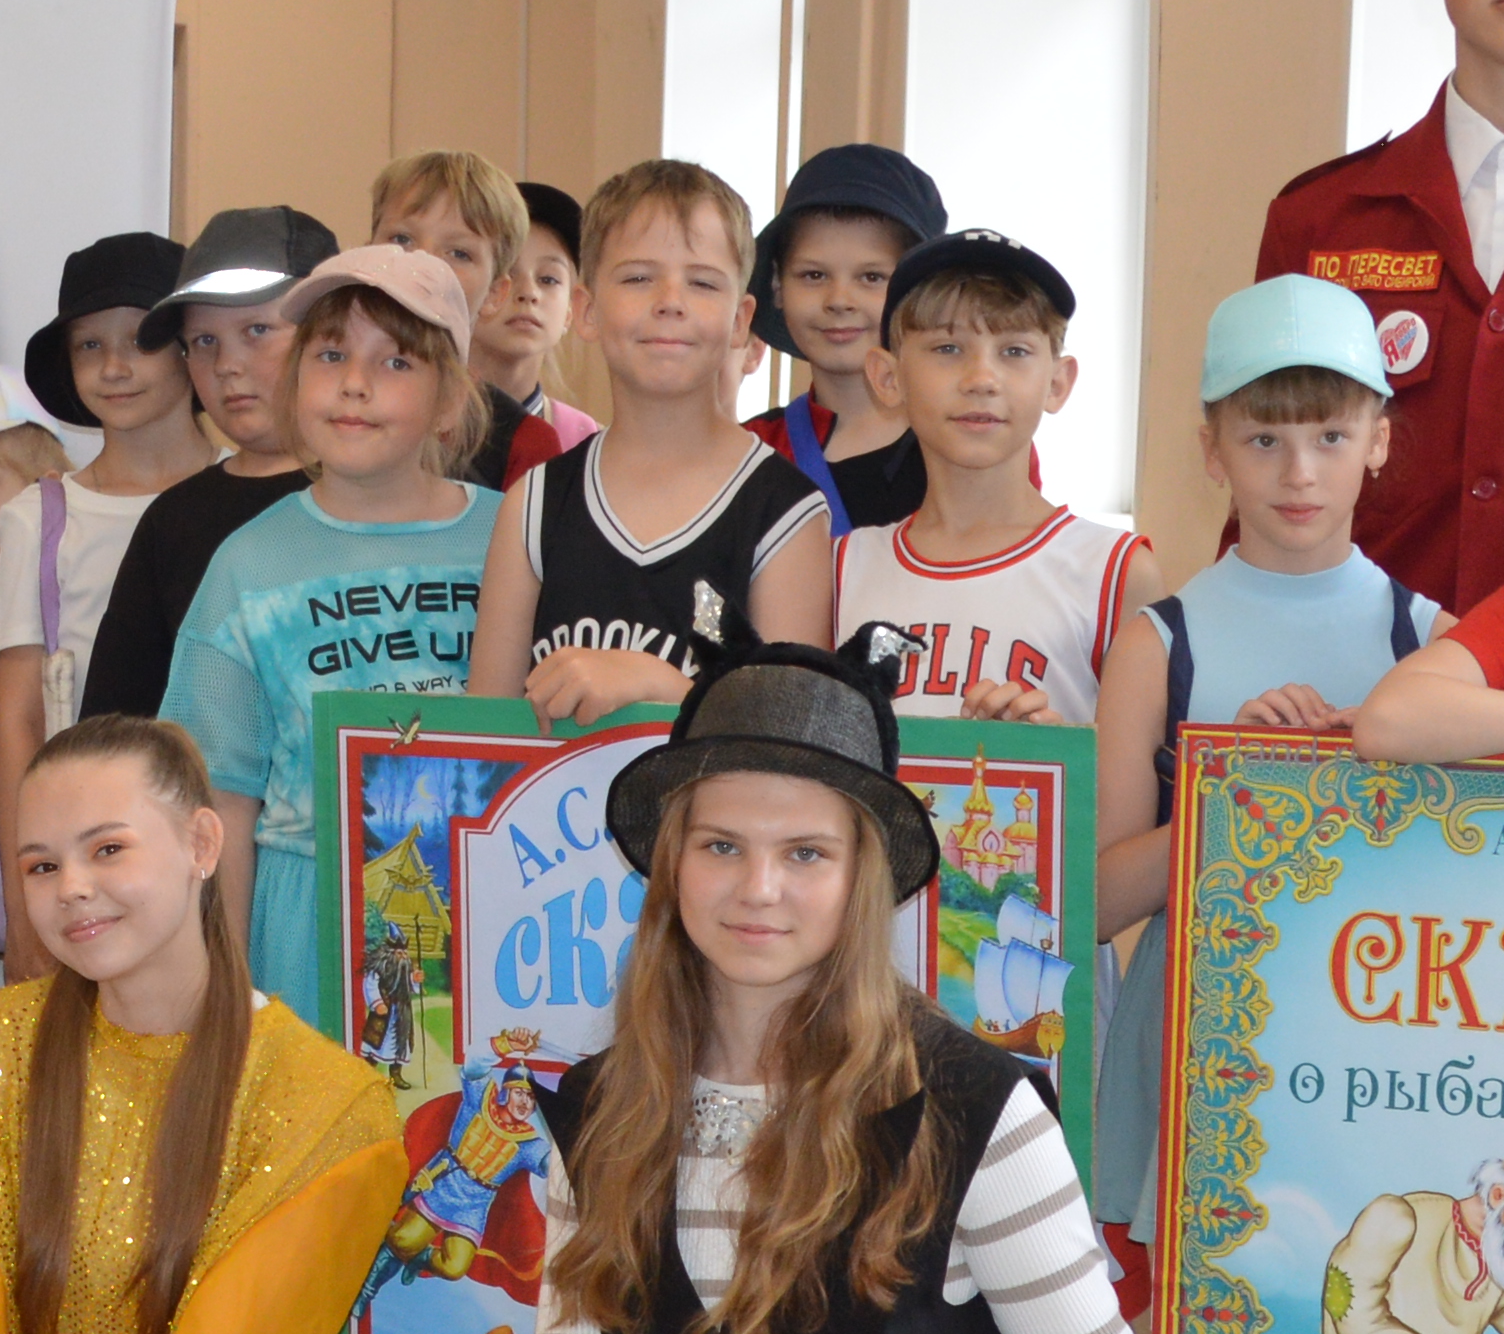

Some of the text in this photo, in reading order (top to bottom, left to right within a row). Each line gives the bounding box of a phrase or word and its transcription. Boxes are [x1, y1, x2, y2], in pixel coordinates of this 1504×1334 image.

[1314, 253, 1438, 278] ПО ПЕРЕСВЕТ
[308, 582, 480, 627] NEVER
[308, 629, 474, 676] GIVE U
[412, 675, 453, 692] WAY
[1289, 1062, 1325, 1104] о
